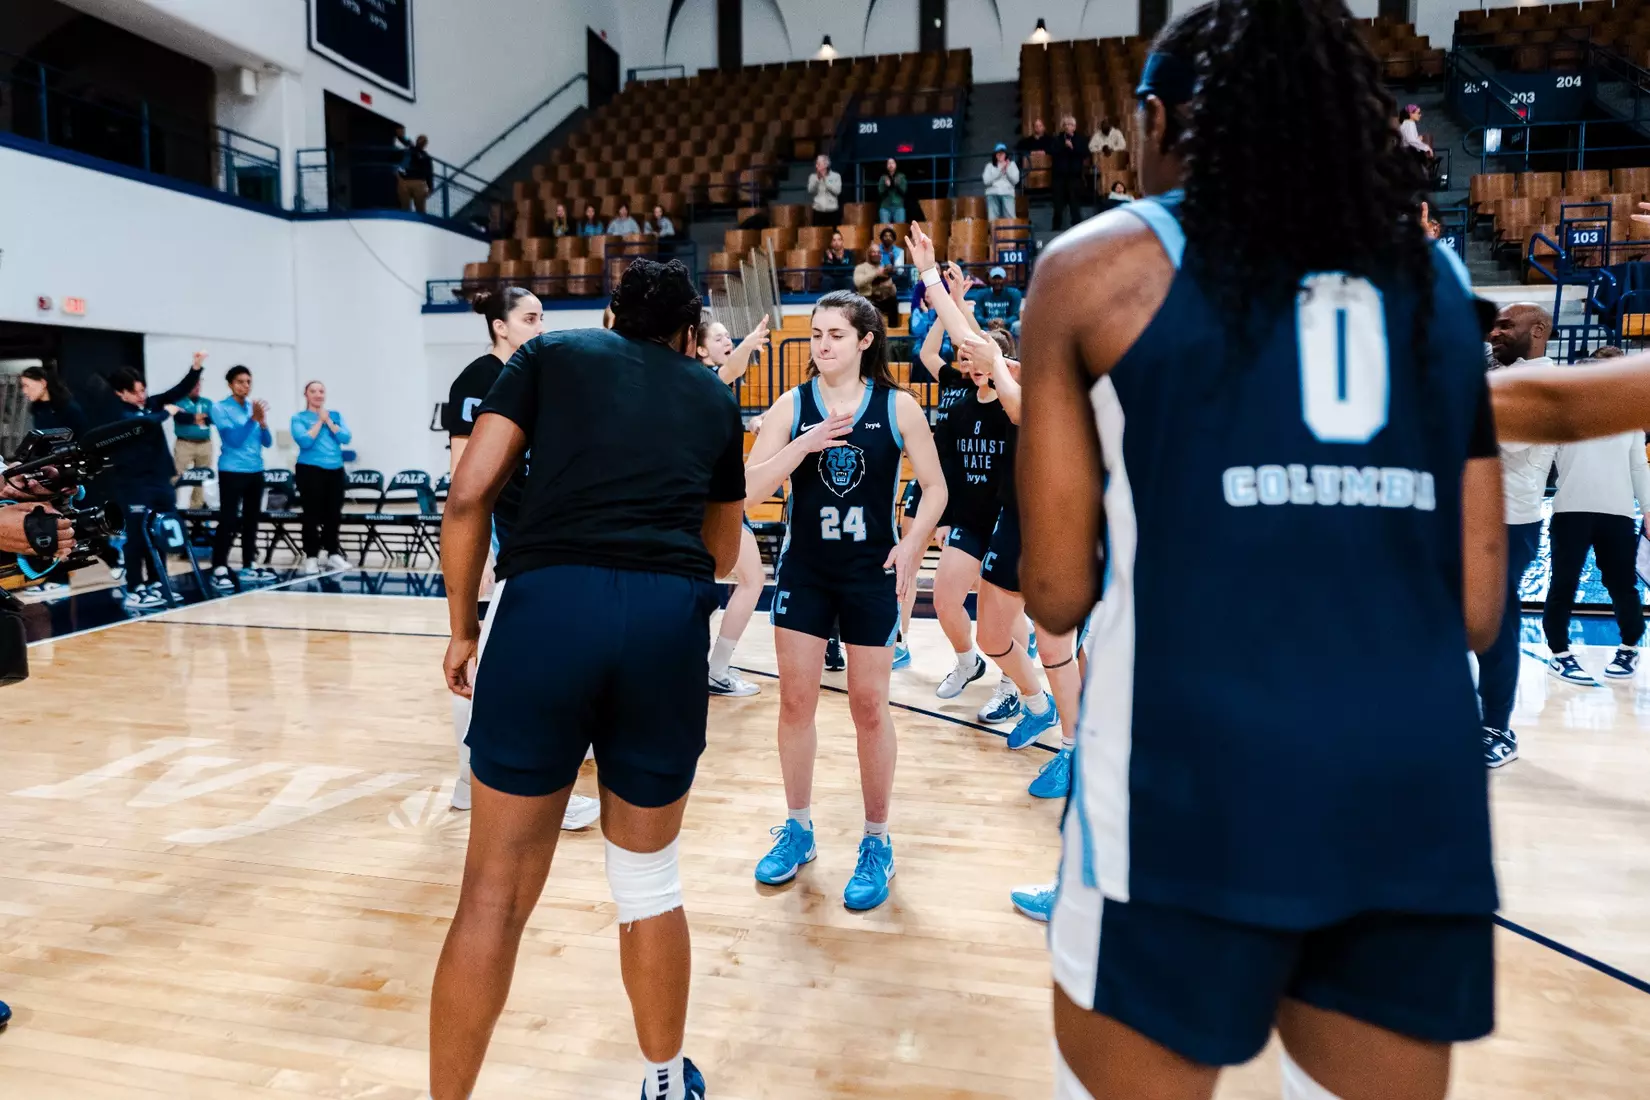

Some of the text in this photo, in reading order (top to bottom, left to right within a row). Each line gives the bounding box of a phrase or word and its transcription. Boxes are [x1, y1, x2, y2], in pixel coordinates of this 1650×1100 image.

[1556, 76, 1581, 88] 204
[1510, 91, 1535, 104] 203
[859, 122, 878, 134] 201
[932, 117, 953, 130] 202
[1440, 237, 1455, 248] 02
[1573, 232, 1598, 243] 103
[1003, 252, 1022, 262] 101
[1295, 271, 1390, 444] 0
[974, 421, 981, 434] 8
[964, 455, 991, 469] HATE
[349, 473, 379, 484] YALE
[395, 473, 426, 484] YALE
[820, 506, 866, 541] 24
[985, 551, 997, 571] C
[776, 591, 790, 614] C
[8, 737, 420, 843] Ivy
